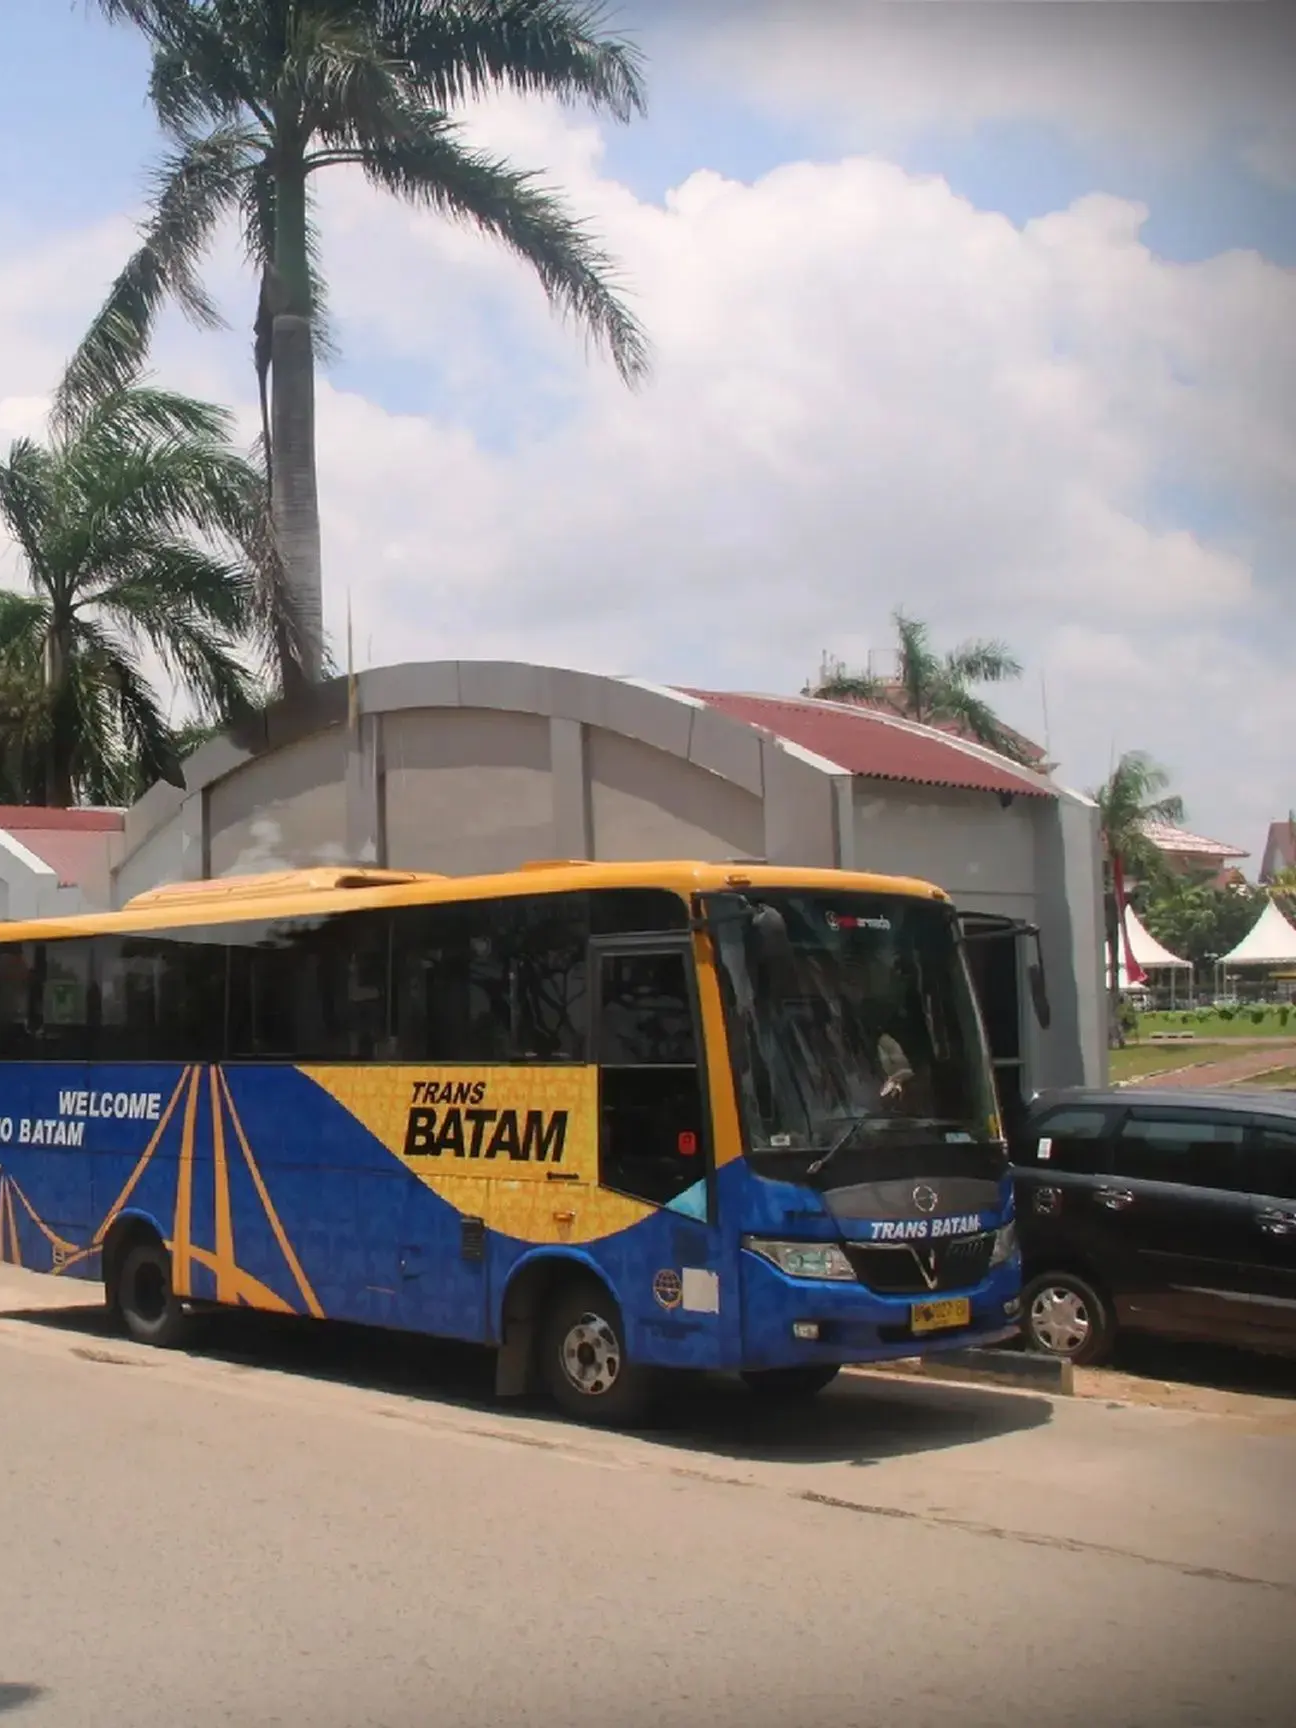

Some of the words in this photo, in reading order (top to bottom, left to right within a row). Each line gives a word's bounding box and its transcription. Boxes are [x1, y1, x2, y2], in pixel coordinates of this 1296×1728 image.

[58, 1091, 161, 1120] WELCOME
[412, 1081, 486, 1104] TRANS
[18, 1118, 84, 1146] BATAM
[404, 1107, 568, 1162] BATAM
[870, 1221, 928, 1239] TRANS
[930, 1214, 981, 1237] BATAM
